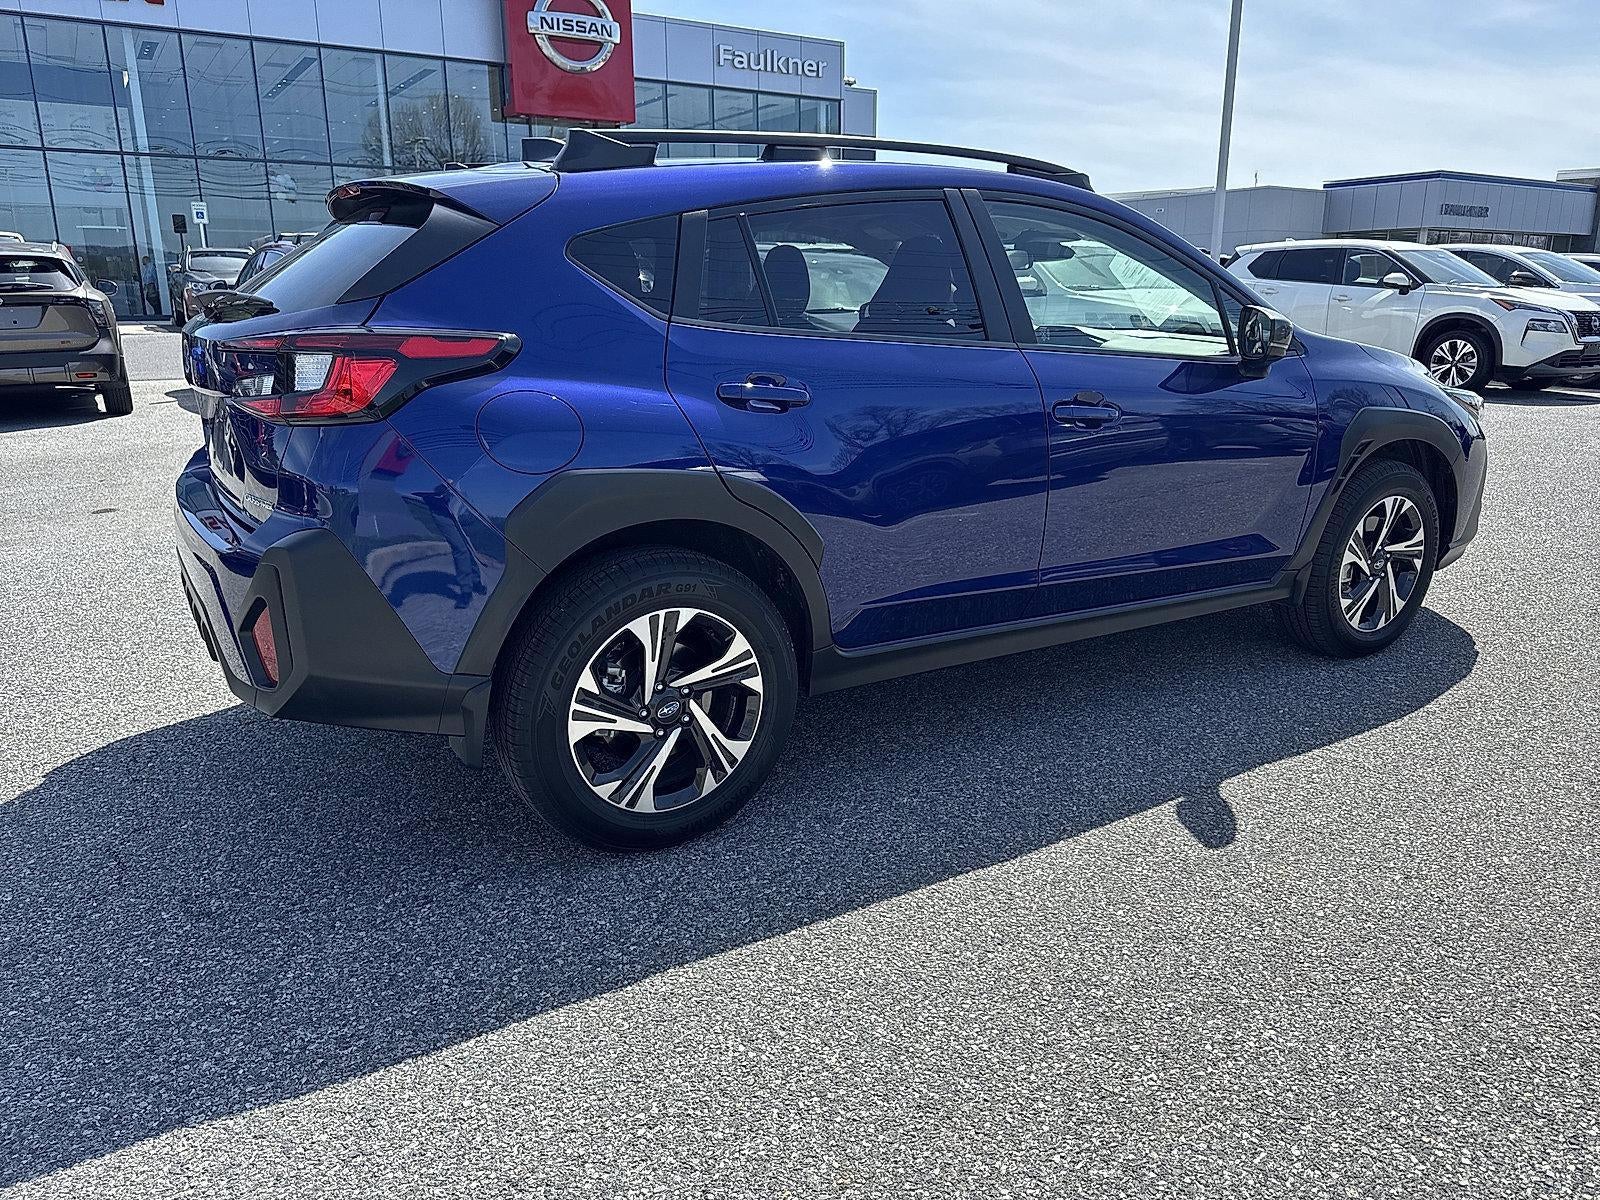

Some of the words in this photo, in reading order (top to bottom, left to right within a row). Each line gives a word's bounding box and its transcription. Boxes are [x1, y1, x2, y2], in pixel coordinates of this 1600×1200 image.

[540, 16, 613, 38] NISSAN
[717, 43, 827, 78] Faulkner
[550, 582, 672, 689] GEOLANDAR
[675, 583, 698, 593] G91
